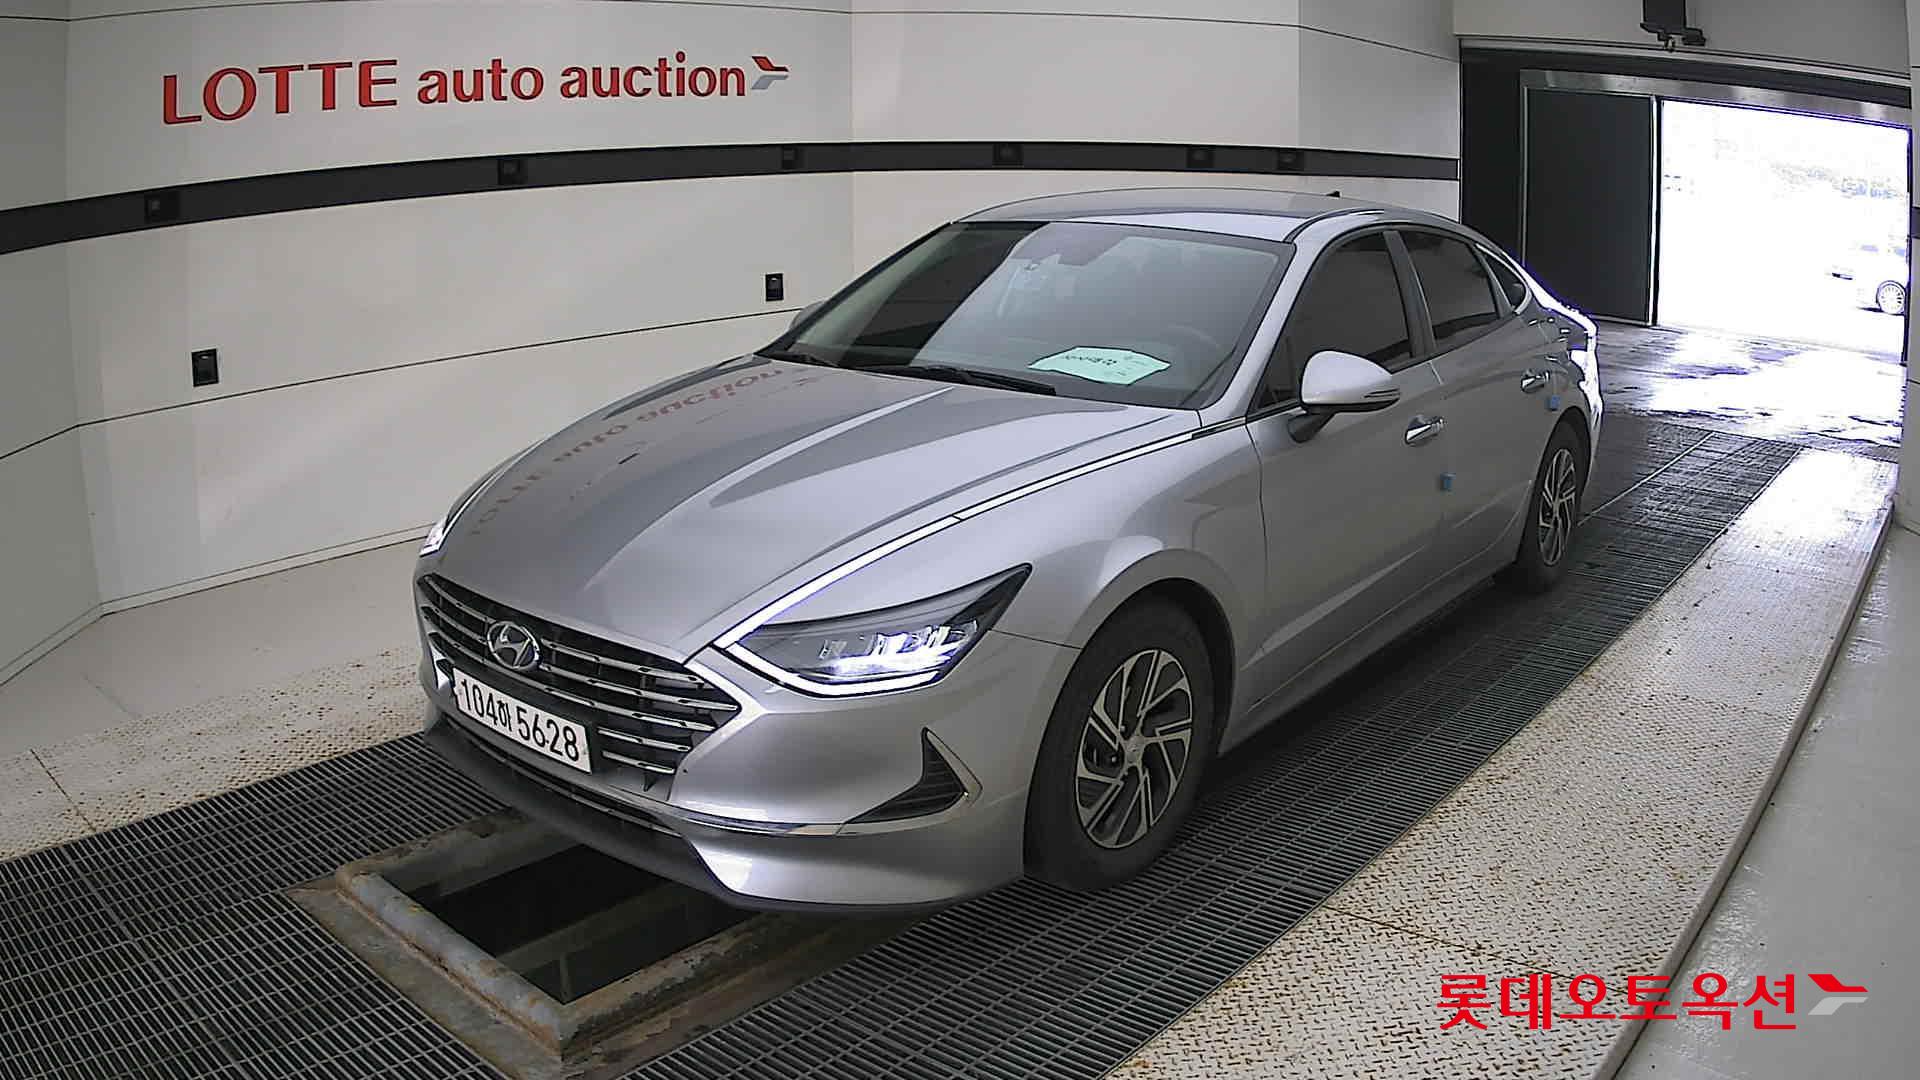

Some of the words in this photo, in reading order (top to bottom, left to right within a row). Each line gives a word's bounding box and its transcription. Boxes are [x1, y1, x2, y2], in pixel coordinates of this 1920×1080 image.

[162, 59, 397, 125] LOTTE
[417, 58, 544, 104] auto
[560, 51, 746, 98] auction
[516, 705, 579, 762] 5628
